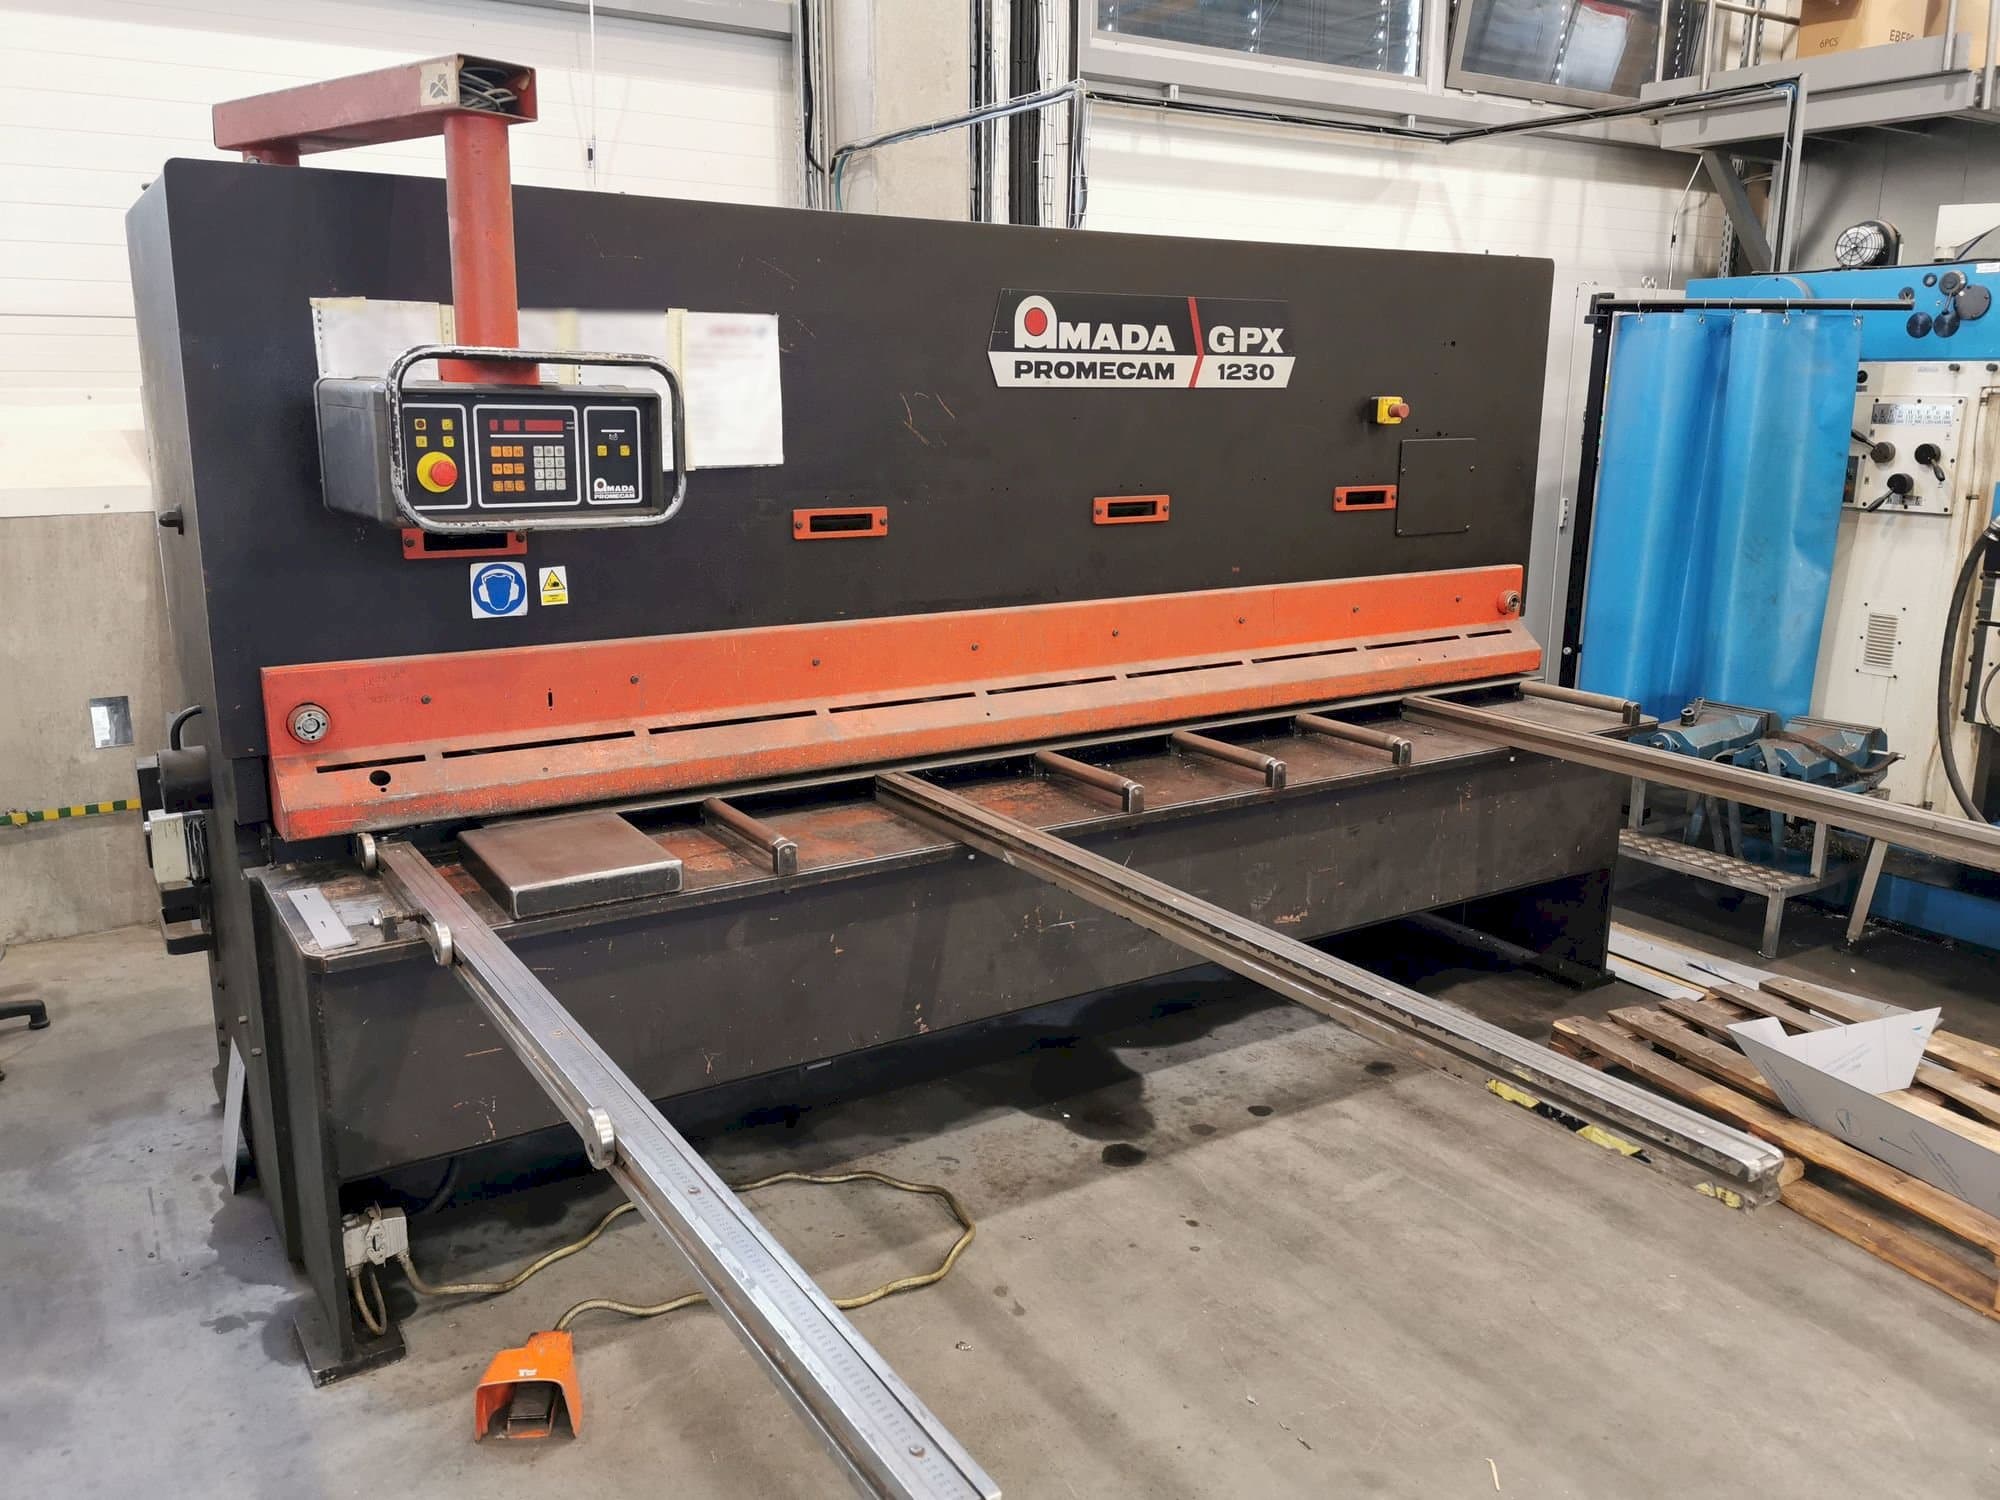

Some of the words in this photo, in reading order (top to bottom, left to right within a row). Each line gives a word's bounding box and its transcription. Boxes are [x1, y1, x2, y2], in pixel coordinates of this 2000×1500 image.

[1014, 295, 1176, 351] AMADA
[1208, 325, 1285, 353] GPX
[1014, 360, 1175, 381] PROMECAM
[1217, 363, 1275, 381] 1230
[594, 478, 635, 491] AMADA
